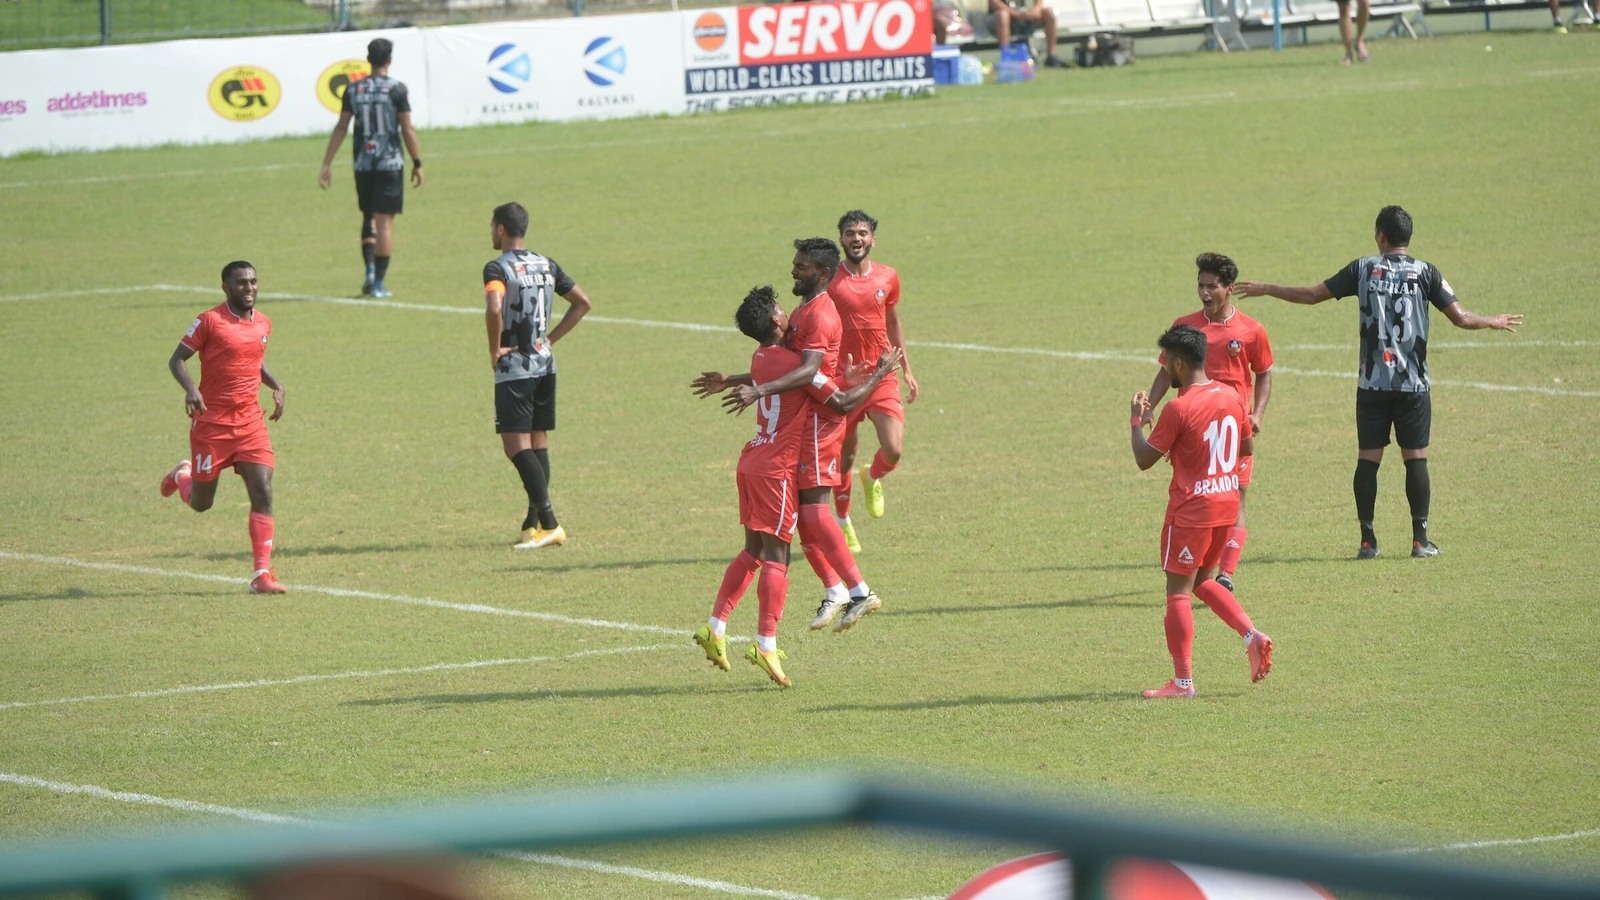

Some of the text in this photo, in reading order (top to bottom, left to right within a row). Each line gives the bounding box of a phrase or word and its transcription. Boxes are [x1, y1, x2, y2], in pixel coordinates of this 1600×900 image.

[743, 0, 915, 59] SERVO
[689, 56, 926, 92] WORLD-CLASS LUBRICANTS
[0, 99, 27, 115] es
[47, 90, 147, 112] addatimes
[481, 101, 540, 114] KALYANI
[577, 95, 635, 107] KALYANI
[1369, 279, 1418, 296] SURAJ
[533, 287, 546, 331] 4
[1377, 295, 1413, 342] 13
[1203, 414, 1239, 476] 10
[195, 453, 213, 474] 14
[1193, 473, 1239, 496] BRANDO
